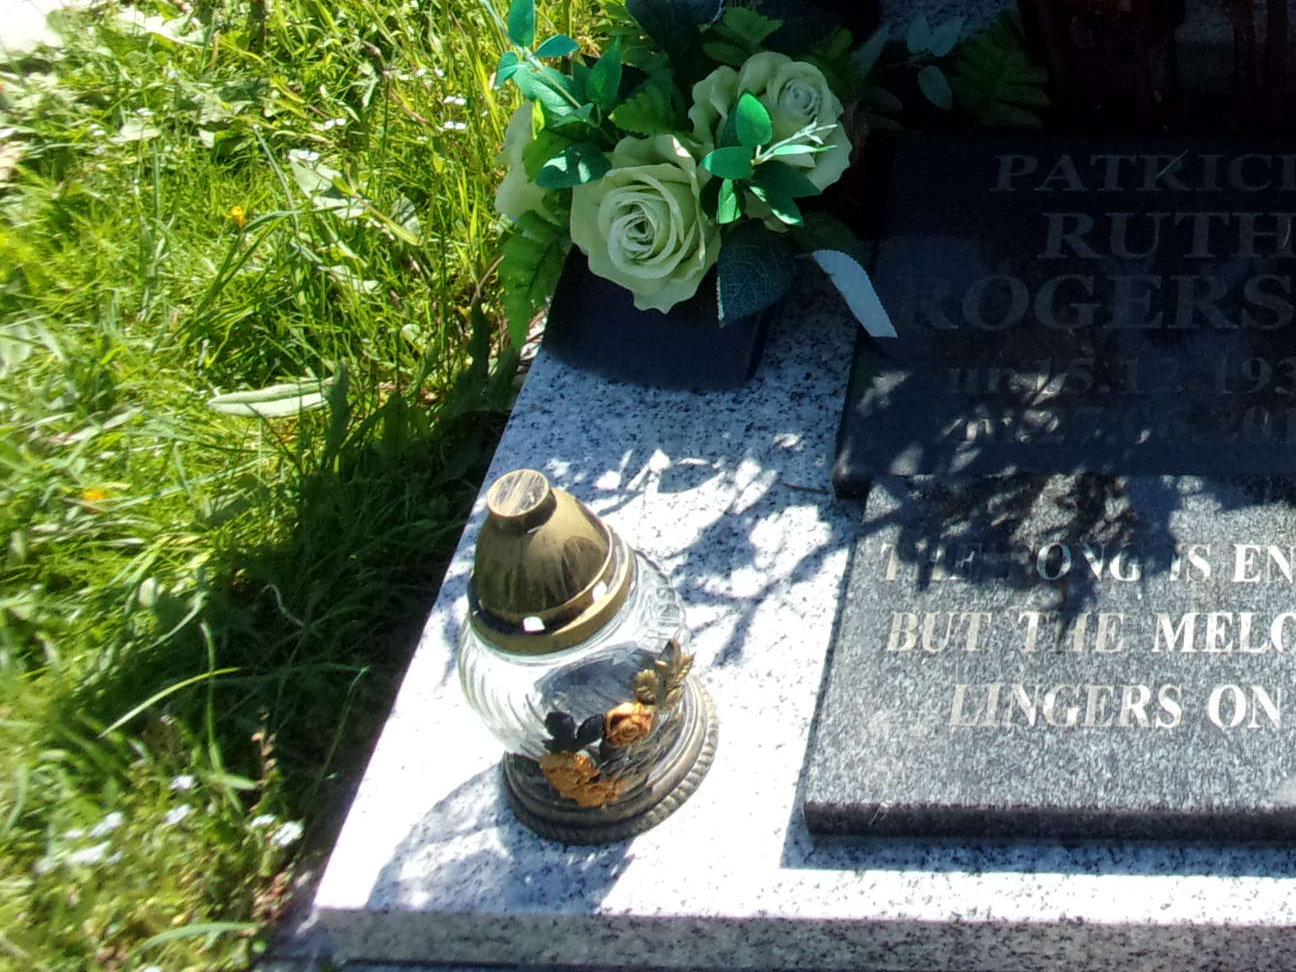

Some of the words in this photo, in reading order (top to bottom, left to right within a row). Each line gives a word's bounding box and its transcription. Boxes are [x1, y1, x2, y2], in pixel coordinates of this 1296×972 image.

[1009, 542, 1142, 582] ONG
[887, 611, 993, 653] BUT
[1017, 611, 1125, 653] THE
[950, 683, 1184, 730] LINGERS
